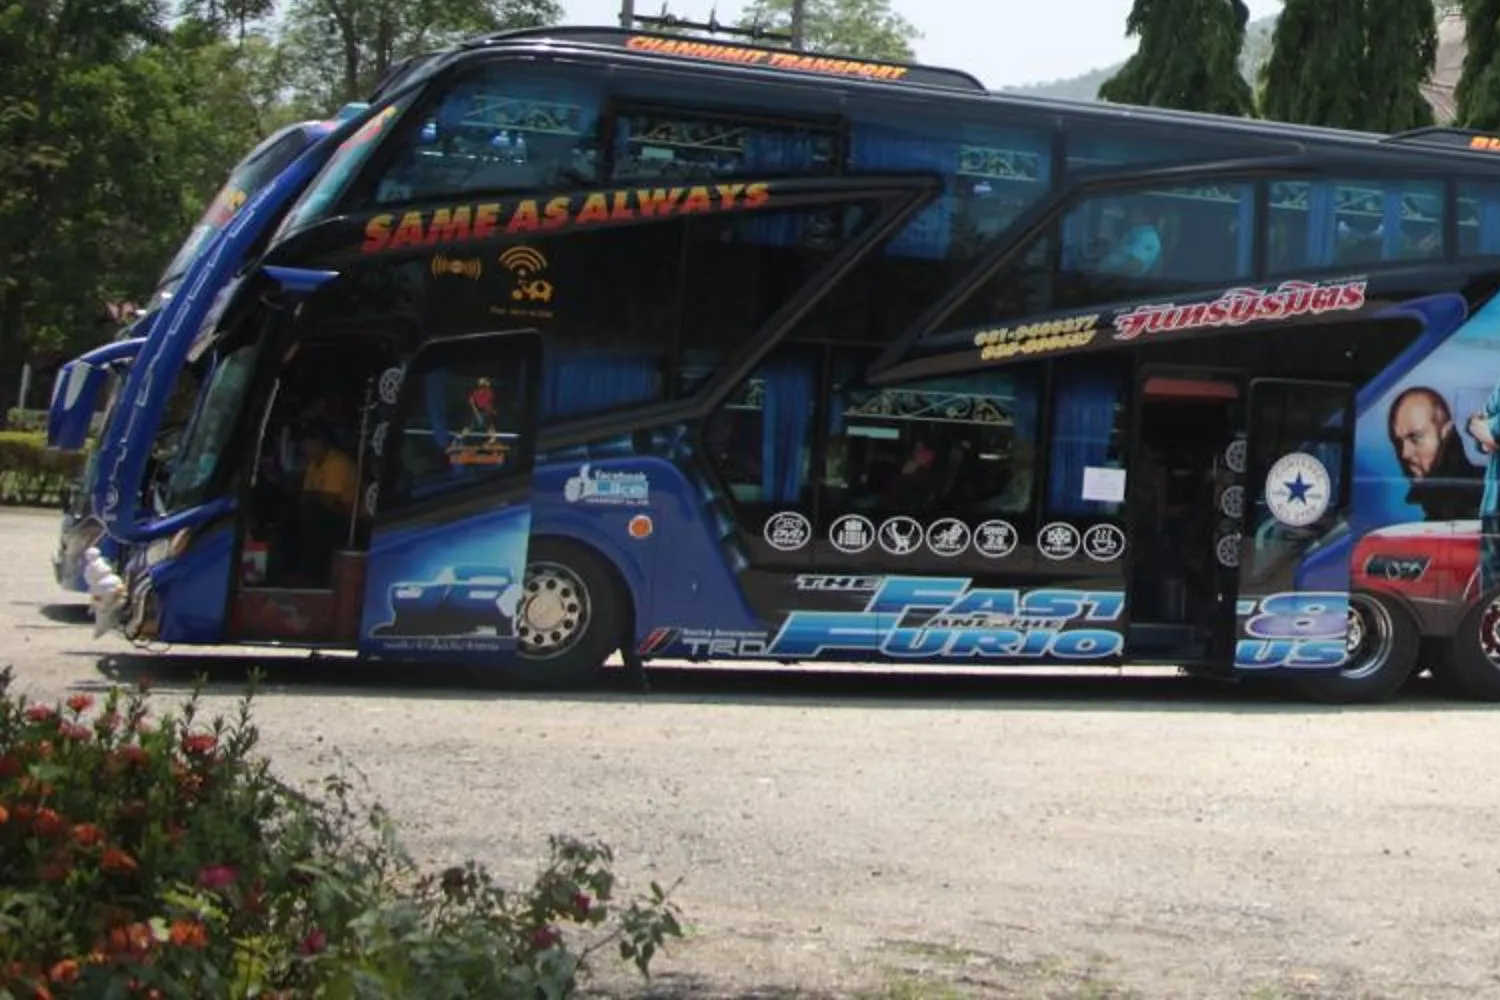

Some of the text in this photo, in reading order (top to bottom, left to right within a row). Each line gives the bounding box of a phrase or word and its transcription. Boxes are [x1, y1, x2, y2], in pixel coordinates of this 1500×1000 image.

[767, 52, 908, 80] TRANSPORT
[361, 182, 770, 254] SAME AS ALWAYS
[795, 574, 1126, 621] THE FAST
[682, 638, 768, 657] TRD
